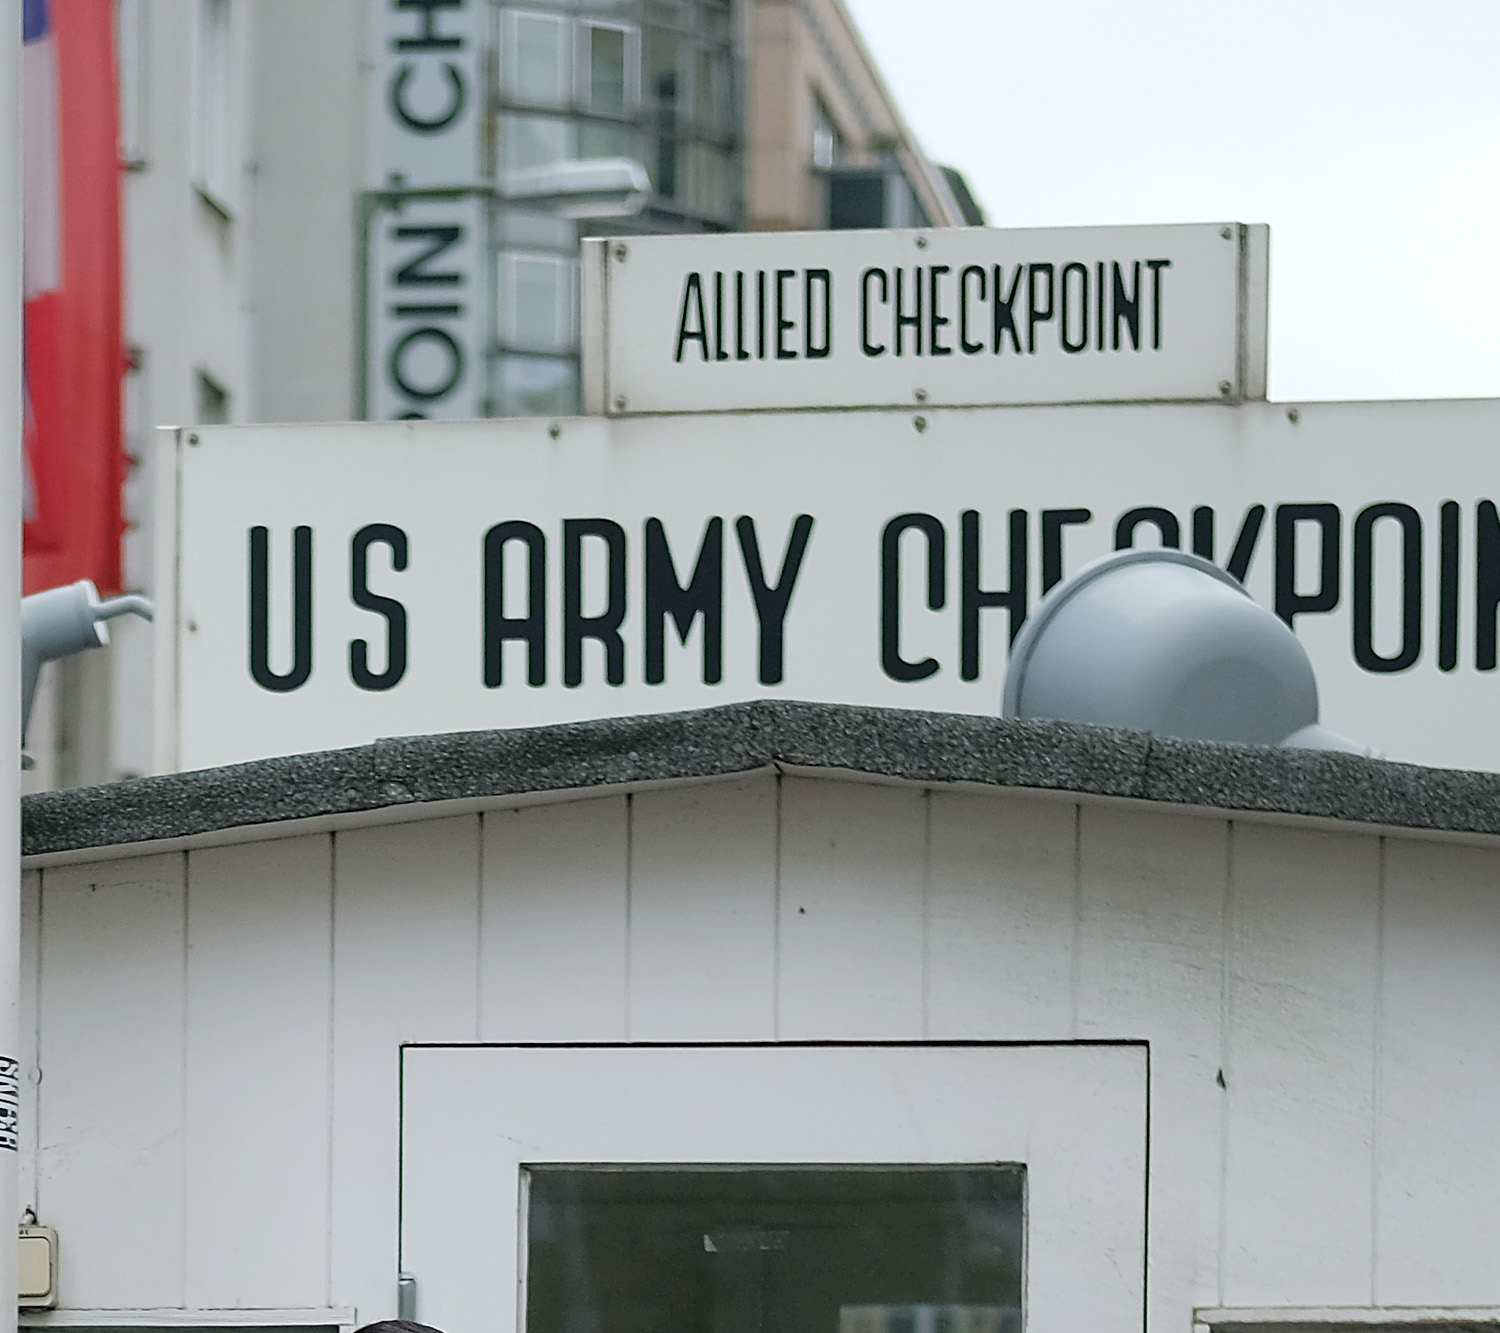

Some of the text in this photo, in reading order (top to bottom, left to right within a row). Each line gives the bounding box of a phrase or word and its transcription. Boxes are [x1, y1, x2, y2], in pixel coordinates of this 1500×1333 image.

[674, 258, 1172, 363] ALLIED CHECKPOINT
[247, 522, 409, 693] US
[482, 514, 815, 690] ARMY
